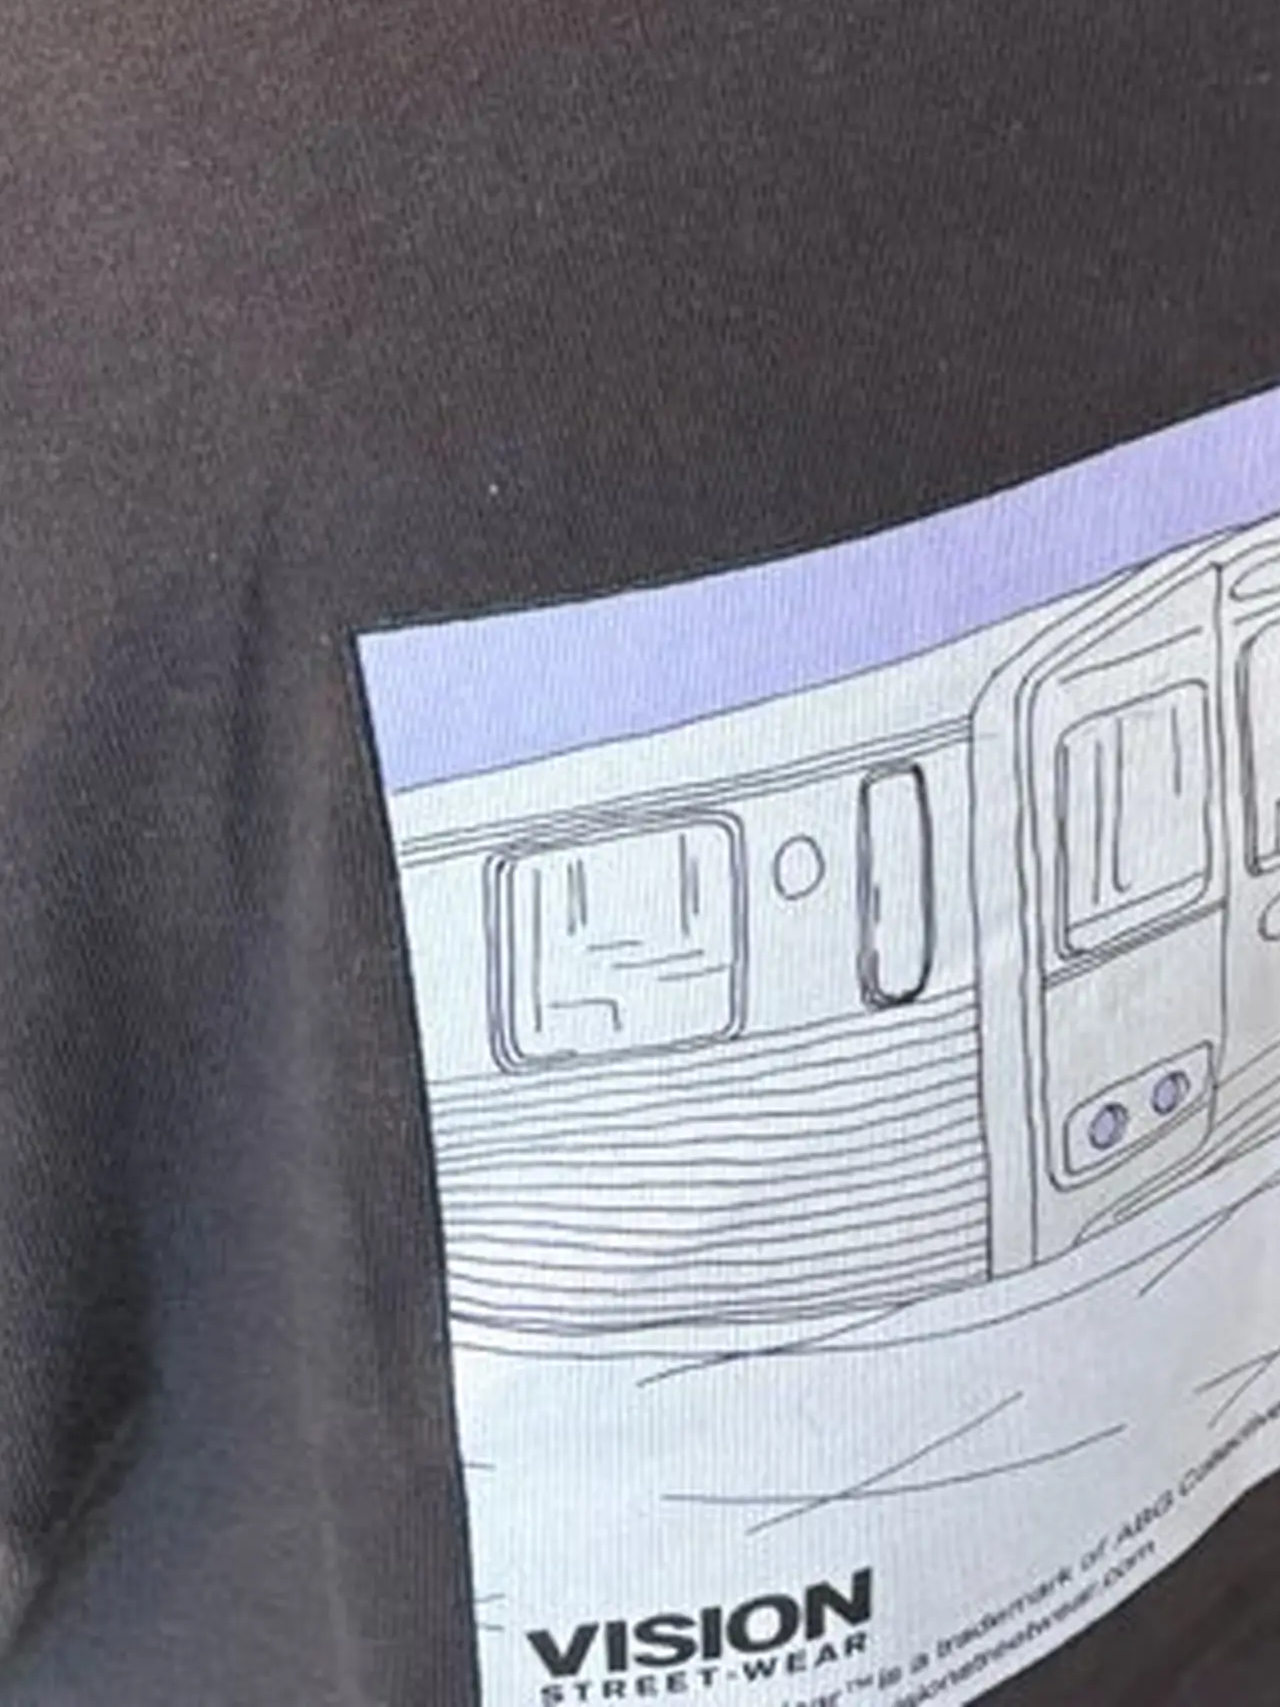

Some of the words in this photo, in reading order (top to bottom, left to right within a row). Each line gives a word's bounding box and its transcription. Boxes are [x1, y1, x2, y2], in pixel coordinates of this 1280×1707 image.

[526, 1566, 872, 1677] VISION
[910, 1652, 929, 1675] a
[936, 1566, 1072, 1658] trademark
[1081, 1536, 1109, 1573] of
[1117, 1490, 1174, 1542] ABG
[540, 1631, 867, 1705] STREET-WEAR
